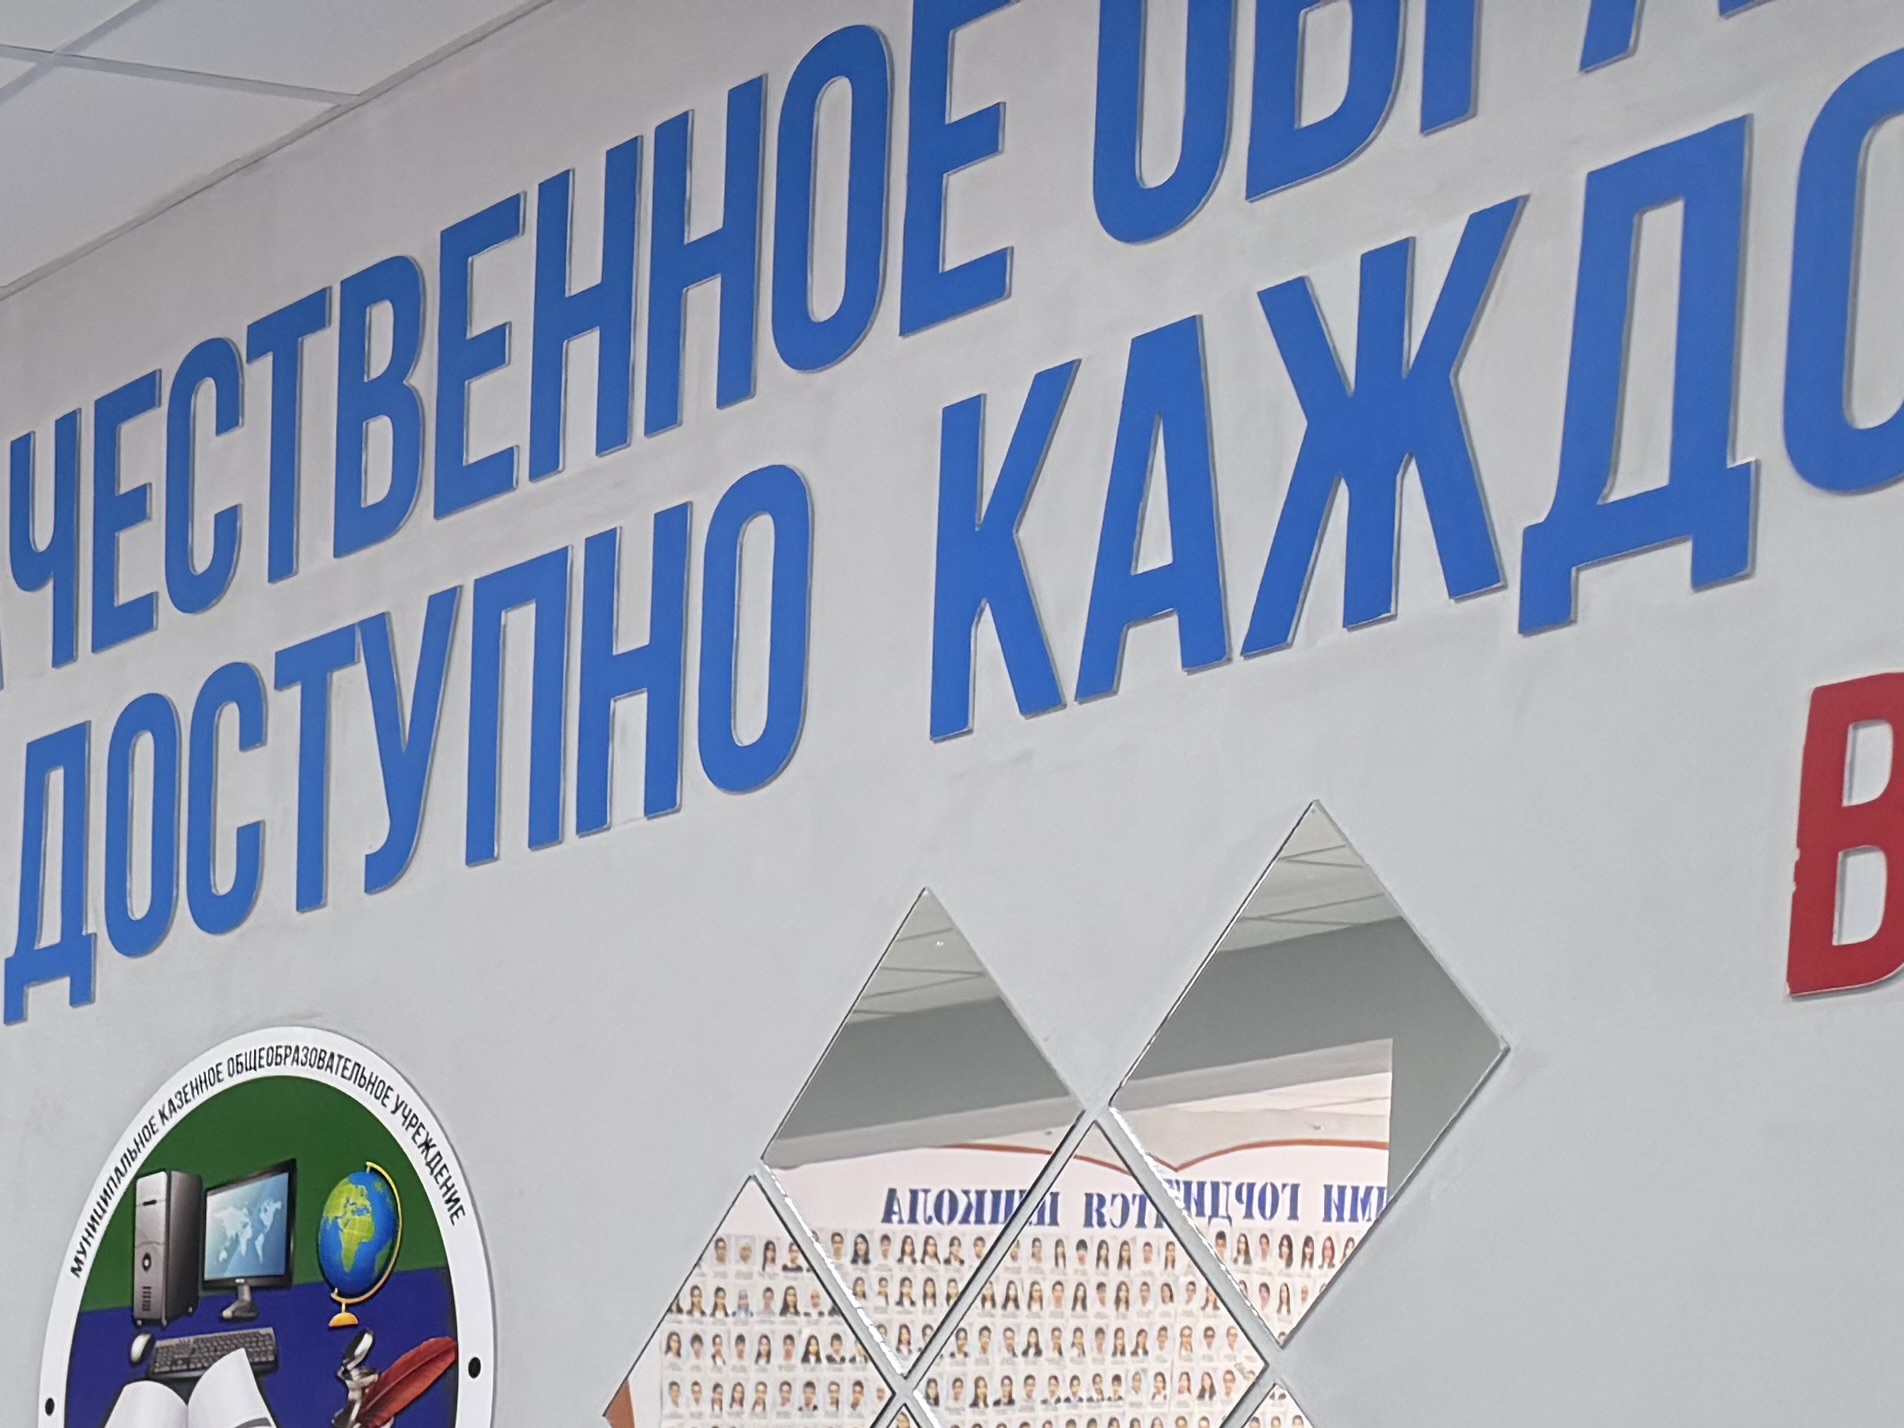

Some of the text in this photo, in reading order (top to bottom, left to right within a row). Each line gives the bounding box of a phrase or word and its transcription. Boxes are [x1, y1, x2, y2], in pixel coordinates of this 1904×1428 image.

[4, 463, 816, 1026] ДОСТУПНО
[69, 1044, 467, 1279] МУНИЦИПАЛЬНОЕ КАЗЕННОЕ ОБЩЕОБРАЗОВАТЕЛЬНОЕ УЧРЕЖДЕНИЕ
